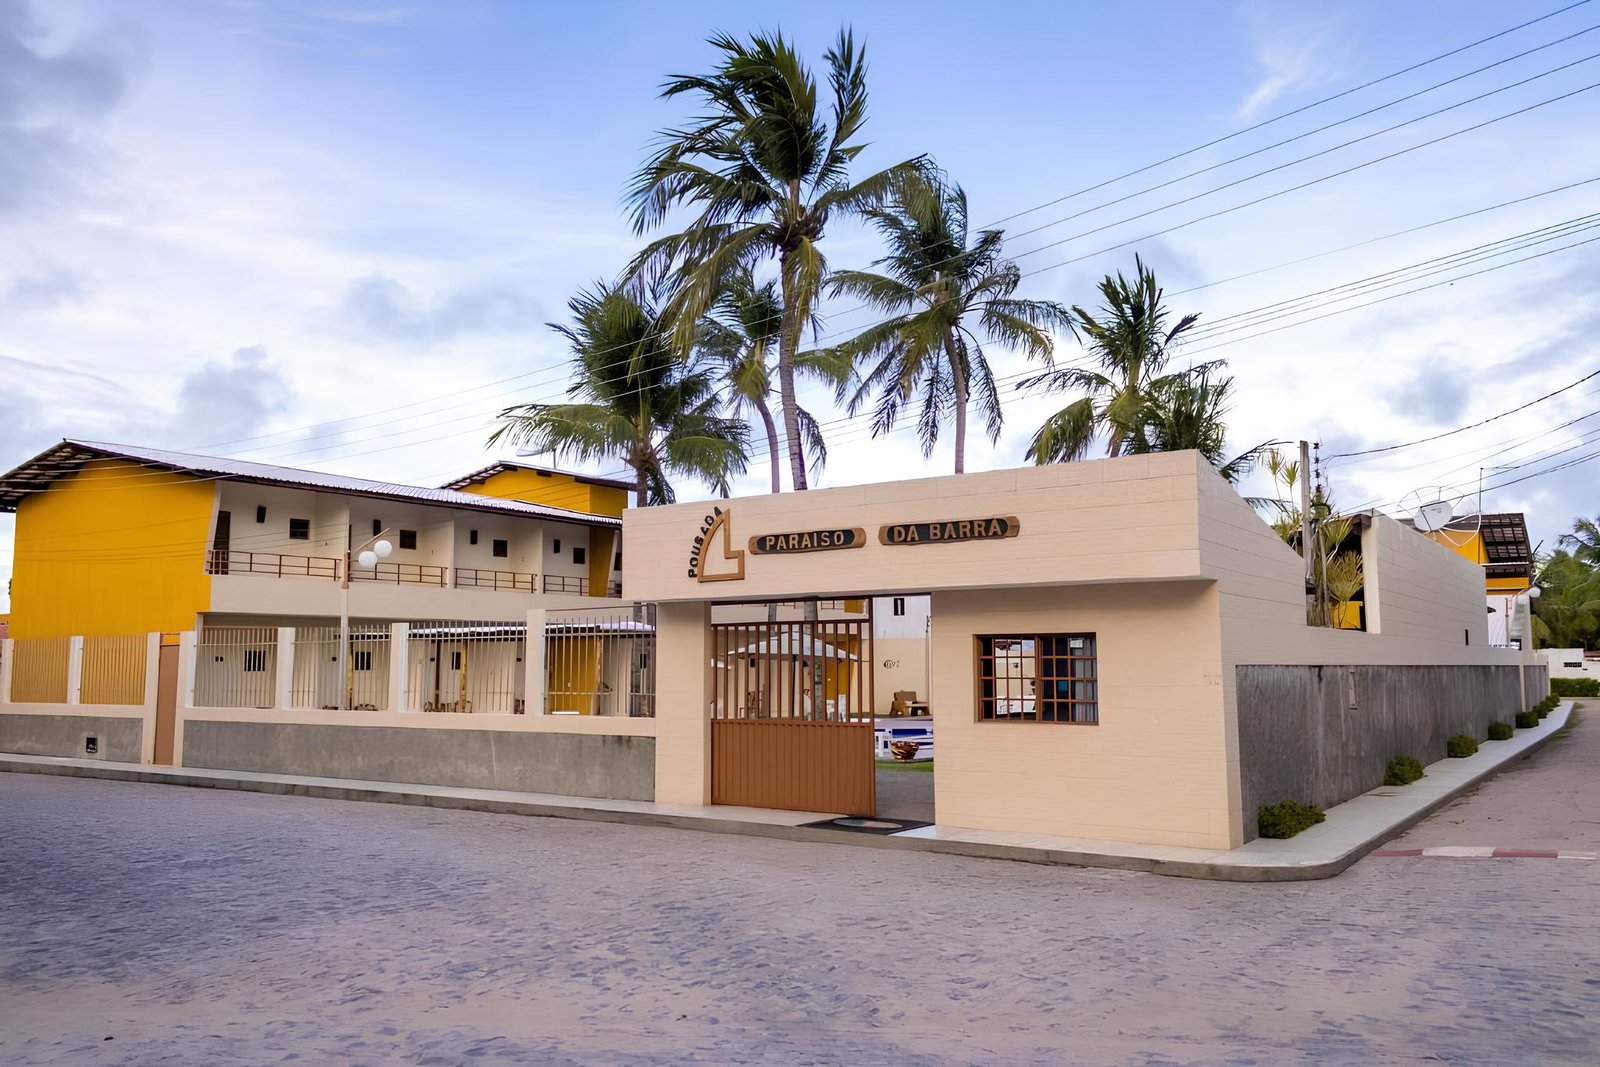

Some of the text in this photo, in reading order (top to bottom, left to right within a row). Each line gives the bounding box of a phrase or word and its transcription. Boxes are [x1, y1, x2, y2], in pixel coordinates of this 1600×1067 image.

[688, 506, 722, 578] POUSADA
[765, 531, 845, 551] PARAISO
[893, 518, 1002, 542] DA BARRA
